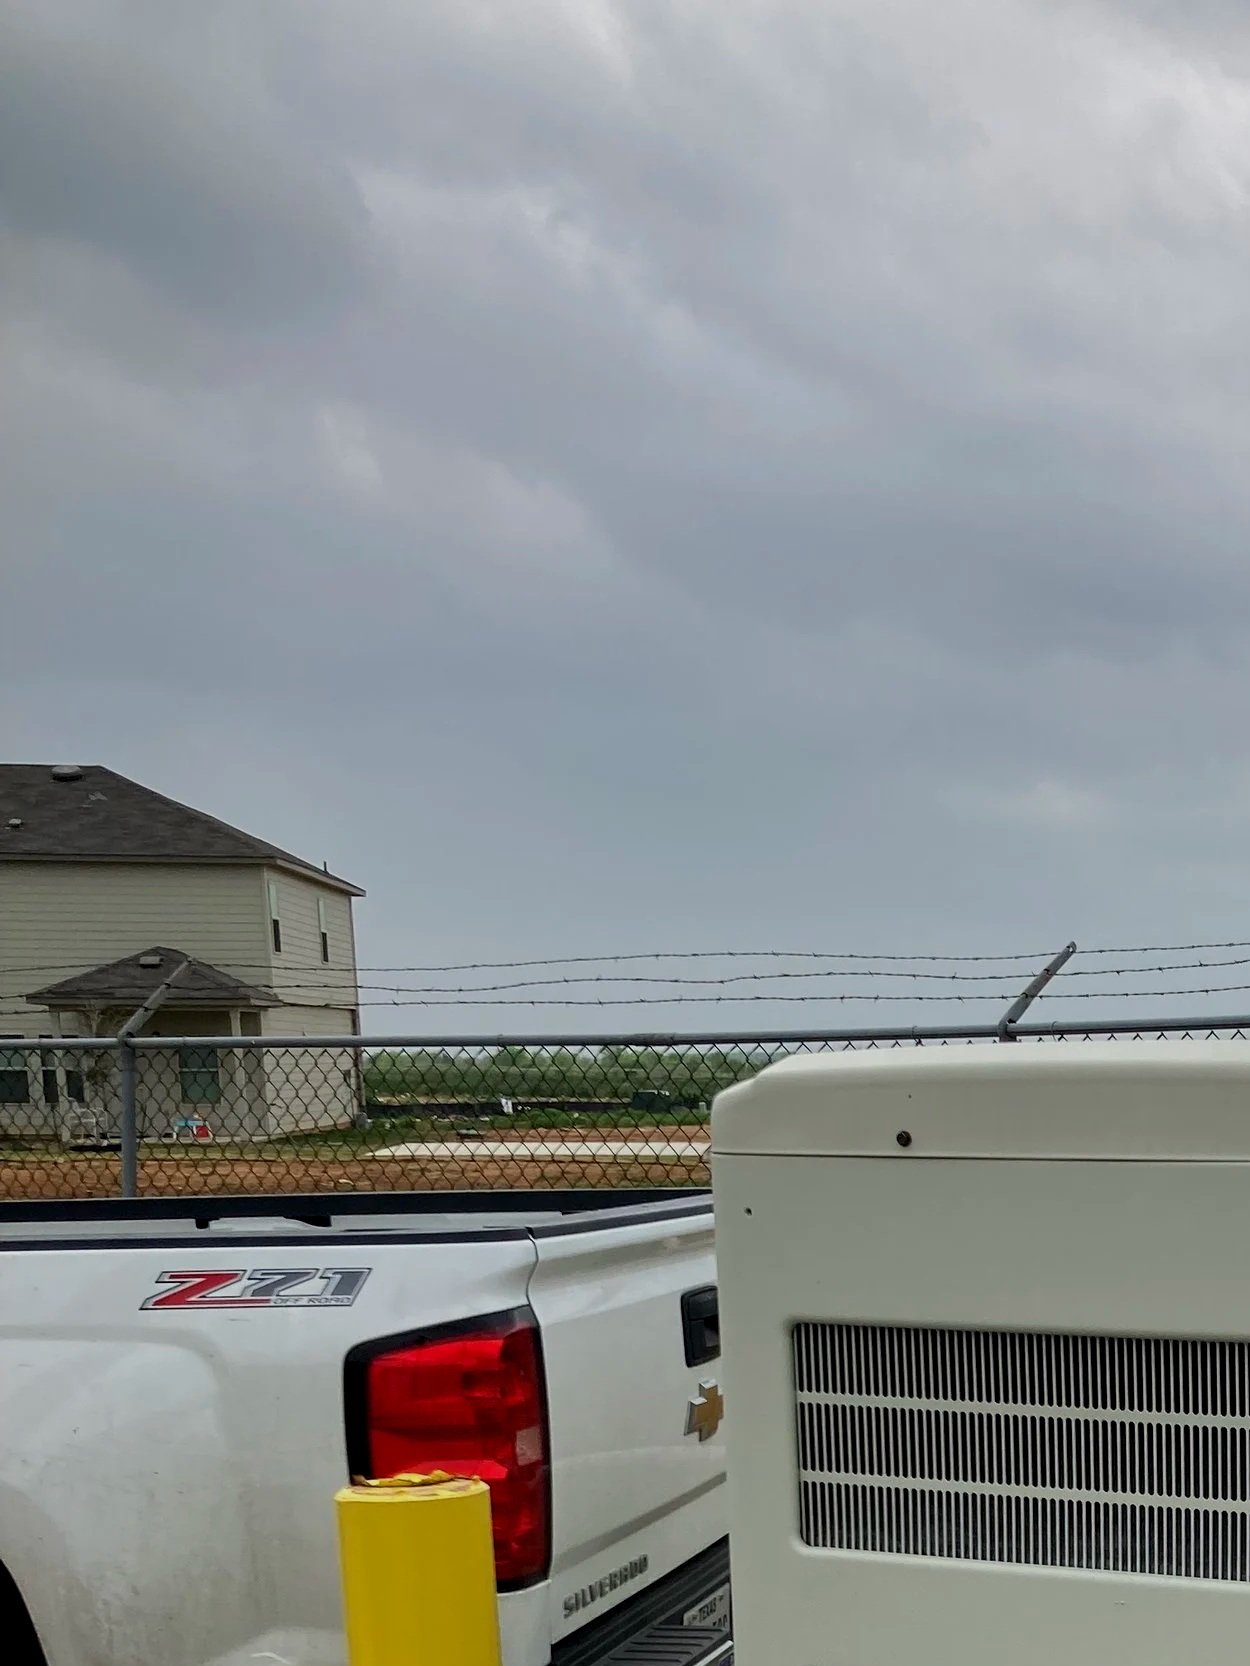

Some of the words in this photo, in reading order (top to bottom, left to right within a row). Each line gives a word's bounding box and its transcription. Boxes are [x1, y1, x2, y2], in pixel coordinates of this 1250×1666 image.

[138, 1267, 373, 1310] Z71
[272, 1297, 302, 1305] OFF
[307, 1296, 352, 1304] ROAD
[562, 1554, 649, 1619] SILVERADO
[698, 1596, 717, 1623] TEXAS
